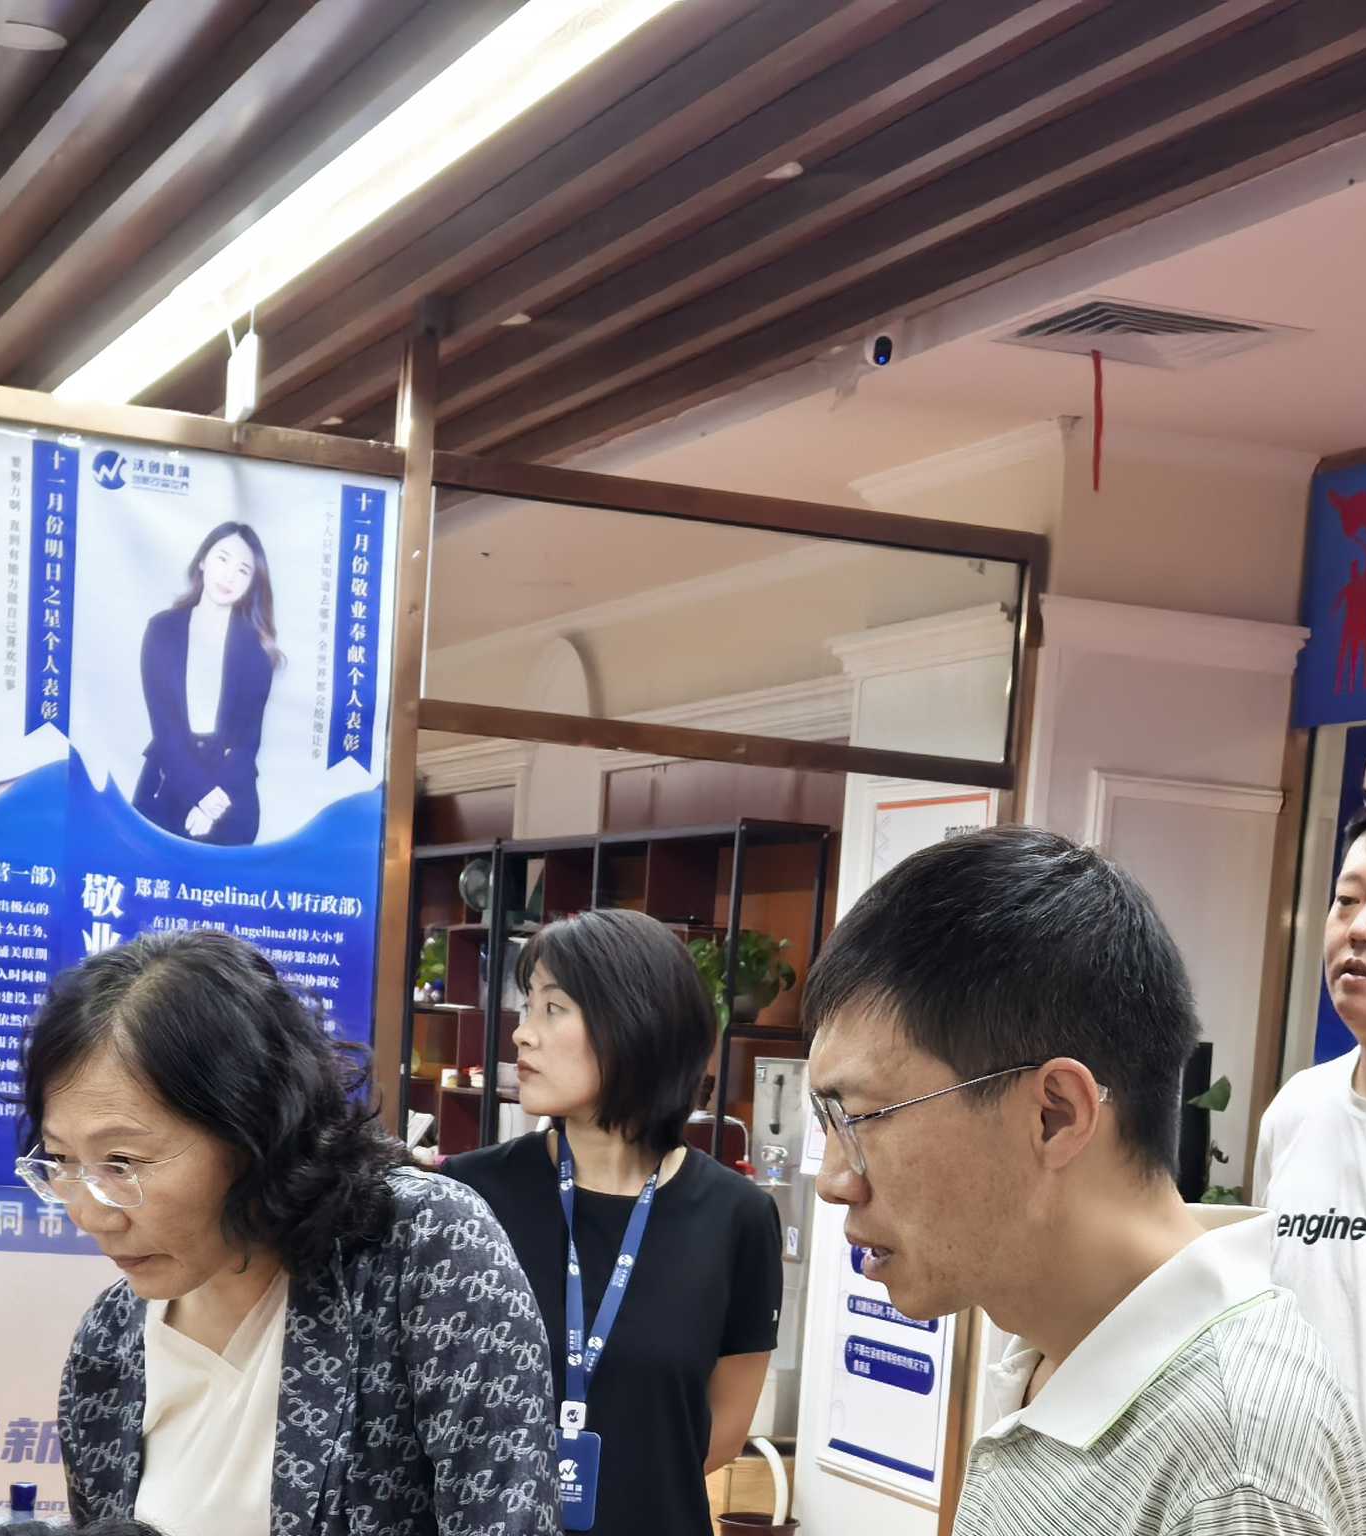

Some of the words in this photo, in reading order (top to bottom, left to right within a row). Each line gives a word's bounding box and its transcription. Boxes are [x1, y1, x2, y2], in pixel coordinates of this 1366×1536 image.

[41, 449, 67, 721] 十一月份明日之星个人表彰
[343, 491, 374, 753] 十一月份敬业奉献个人表彰
